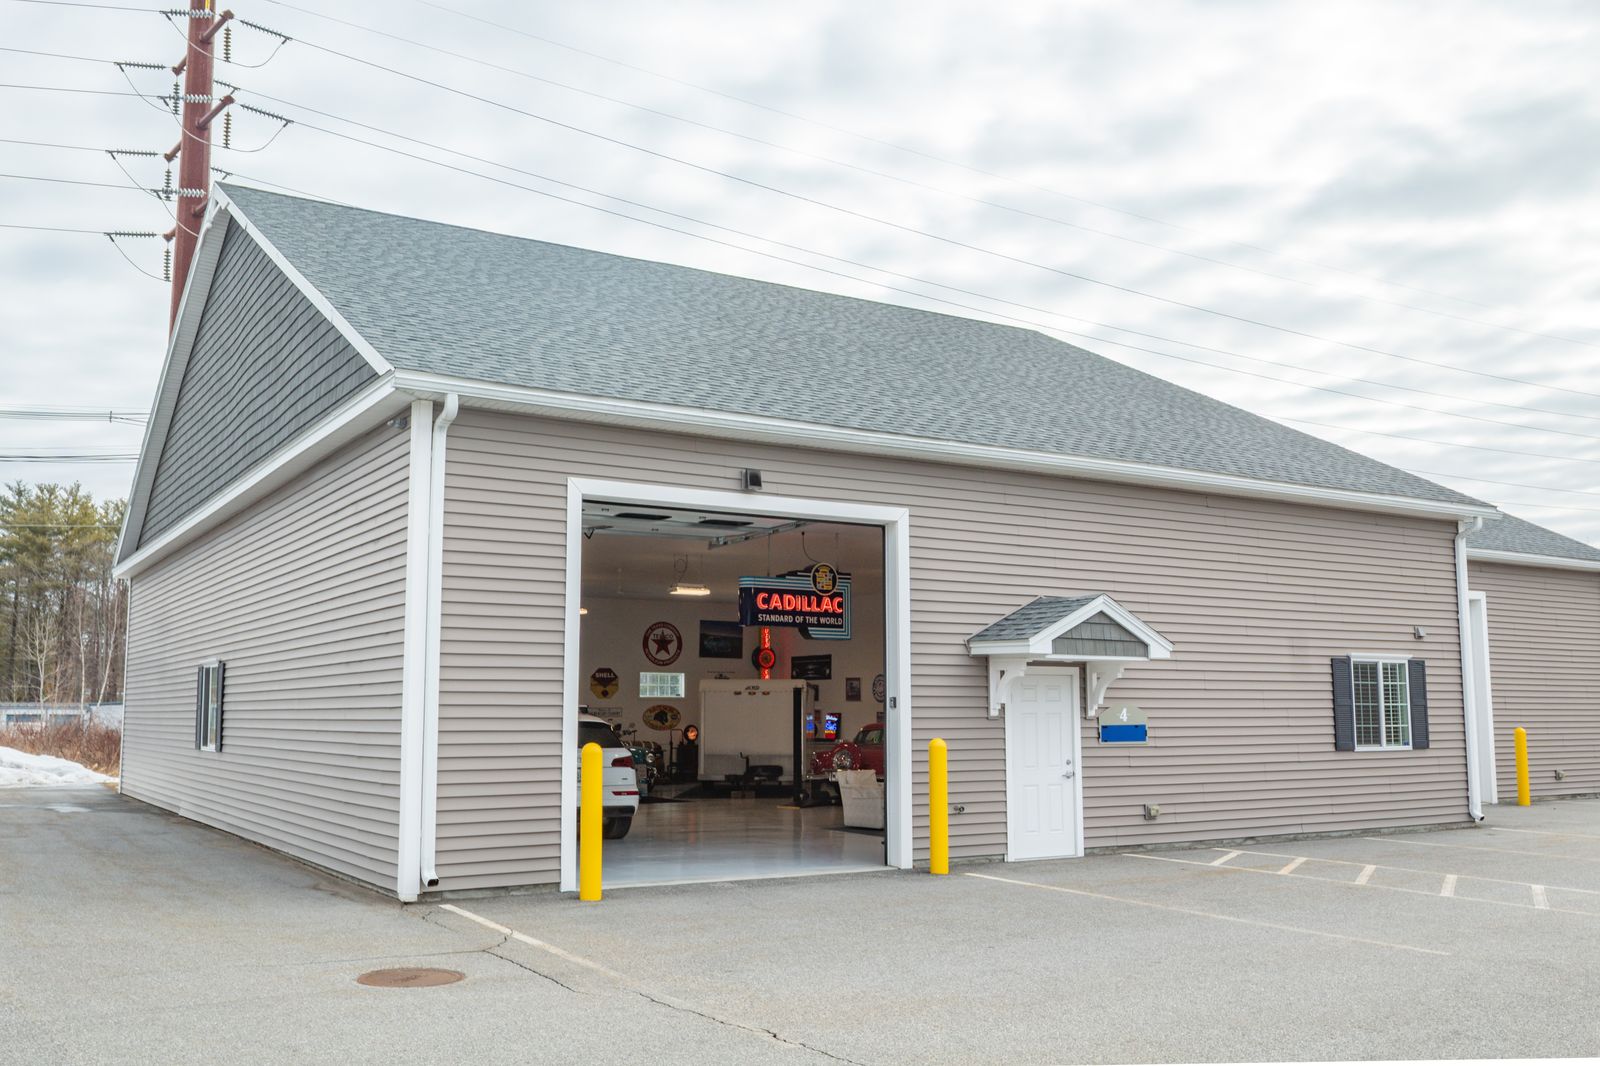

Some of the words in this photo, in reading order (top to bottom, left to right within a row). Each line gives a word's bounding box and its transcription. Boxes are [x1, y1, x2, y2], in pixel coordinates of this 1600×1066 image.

[756, 593, 843, 613] CADILLAC
[758, 614, 794, 623] STANDARD
[795, 616, 804, 624] OF
[806, 616, 818, 624] THE
[819, 617, 843, 625] WORLD
[1120, 708, 1128, 722] 4
